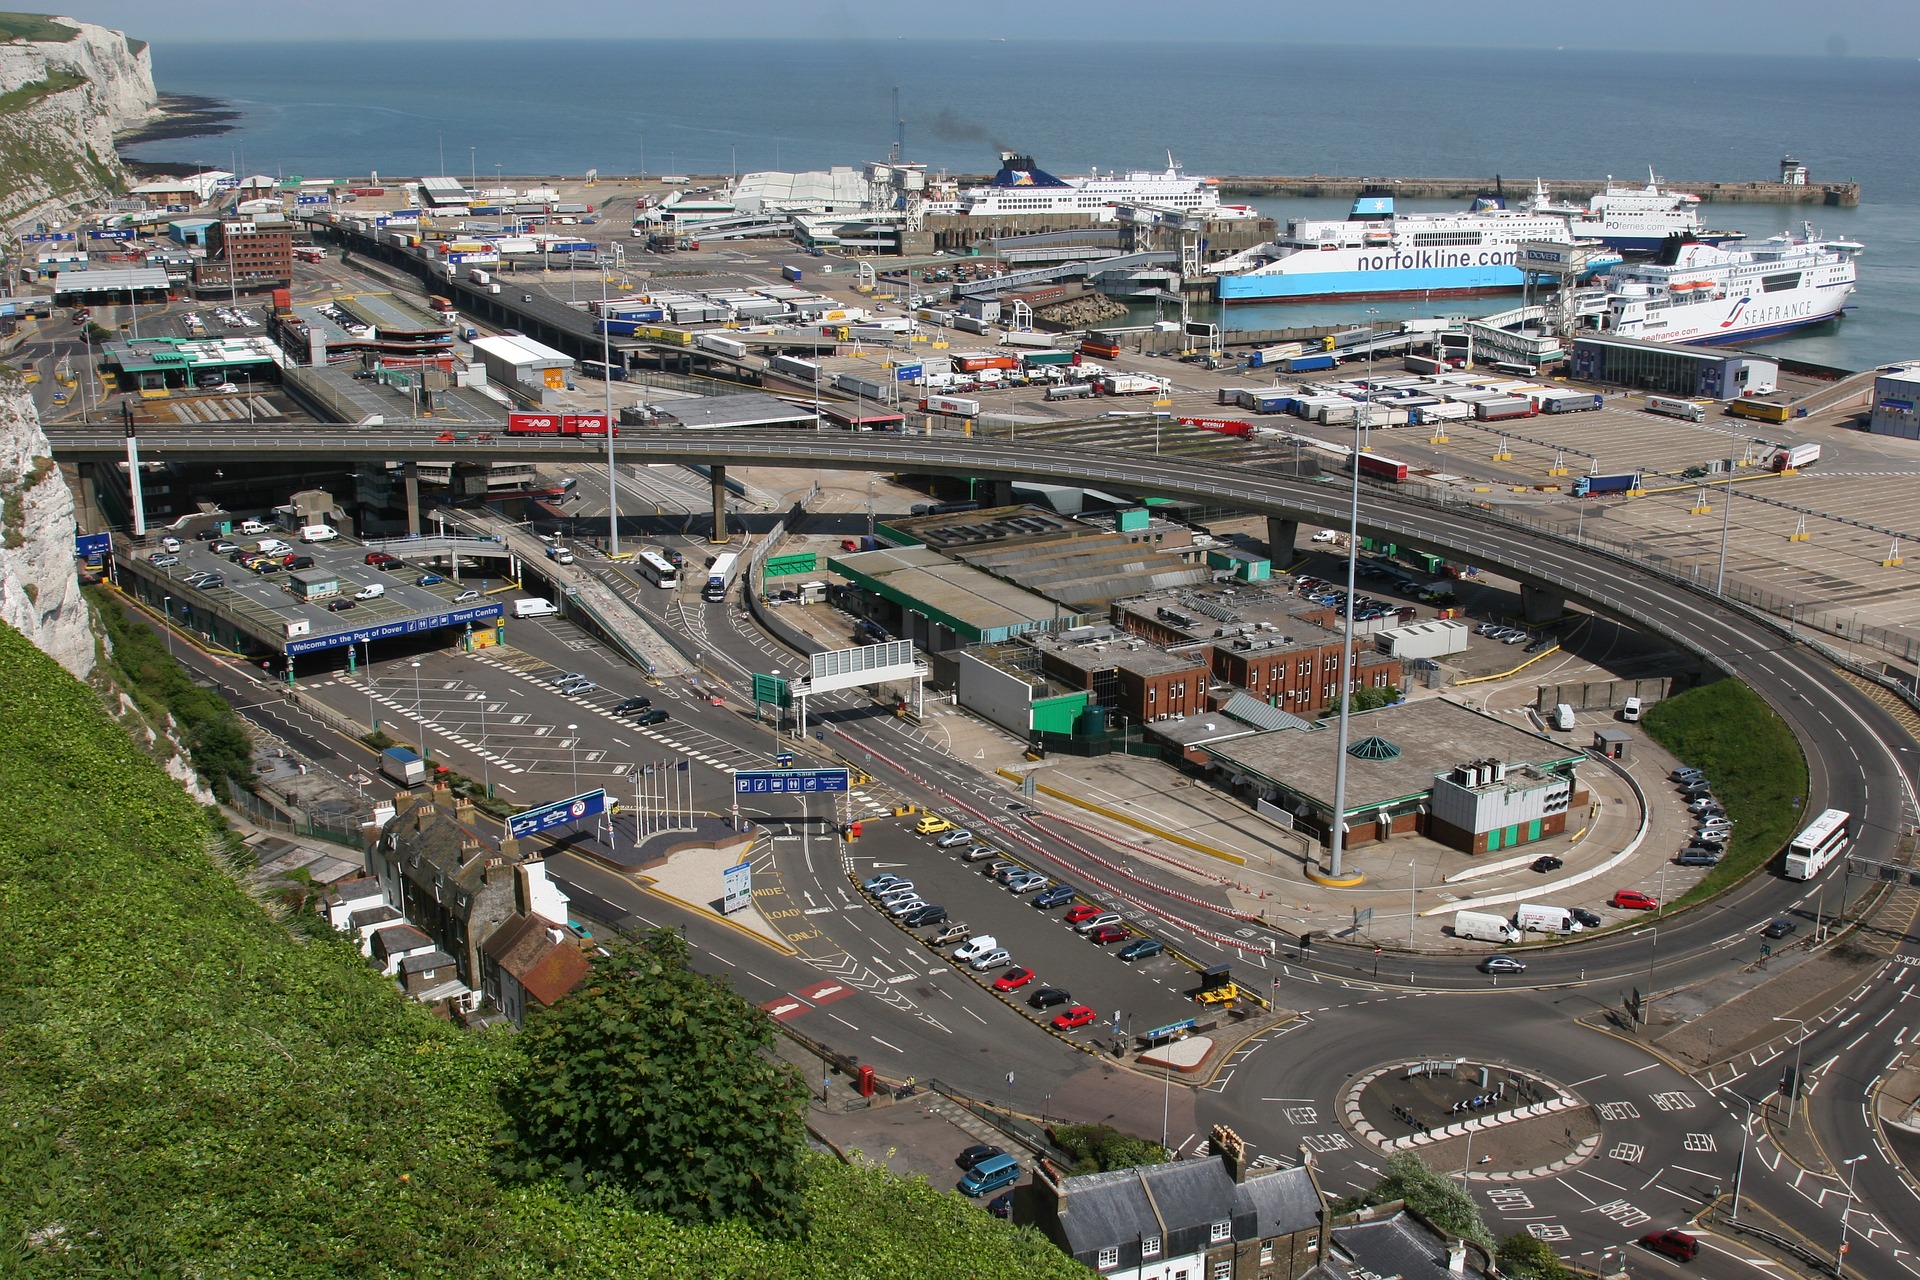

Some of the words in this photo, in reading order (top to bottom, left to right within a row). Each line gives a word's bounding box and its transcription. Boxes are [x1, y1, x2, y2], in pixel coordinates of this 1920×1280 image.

[1606, 222, 1665, 230] POferries.com
[1358, 250, 1517, 271] norfolkline.com
[1530, 252, 1557, 260] DOVER
[1744, 301, 1812, 325] SEAFRANCE
[1642, 327, 1699, 341] seafrance.com
[453, 611, 473, 622] Travel
[475, 607, 498, 618] Centre
[293, 640, 327, 652] Welcome
[329, 637, 337, 645] to
[339, 634, 351, 643] the
[354, 631, 369, 640] Port
[371, 629, 380, 637] of
[381, 625, 403, 635] Dover
[573, 804, 584, 812] 20
[752, 887, 783, 897] WIDE
[765, 908, 799, 920] LOAD
[787, 929, 818, 942] ONLY
[1159, 1027, 1174, 1036] Eastern
[1595, 1101, 1641, 1120] CLEAR
[1648, 1092, 1696, 1111] CLEAR
[1282, 1106, 1318, 1125] KEEP
[1302, 1133, 1354, 1153] CLEAR
[1684, 1132, 1717, 1152] KEEP
[1608, 1142, 1644, 1163] KEEP
[1486, 1188, 1535, 1211] CLEAR
[1599, 1198, 1651, 1227] CLEAR
[1526, 1223, 1573, 1242] KEEP
